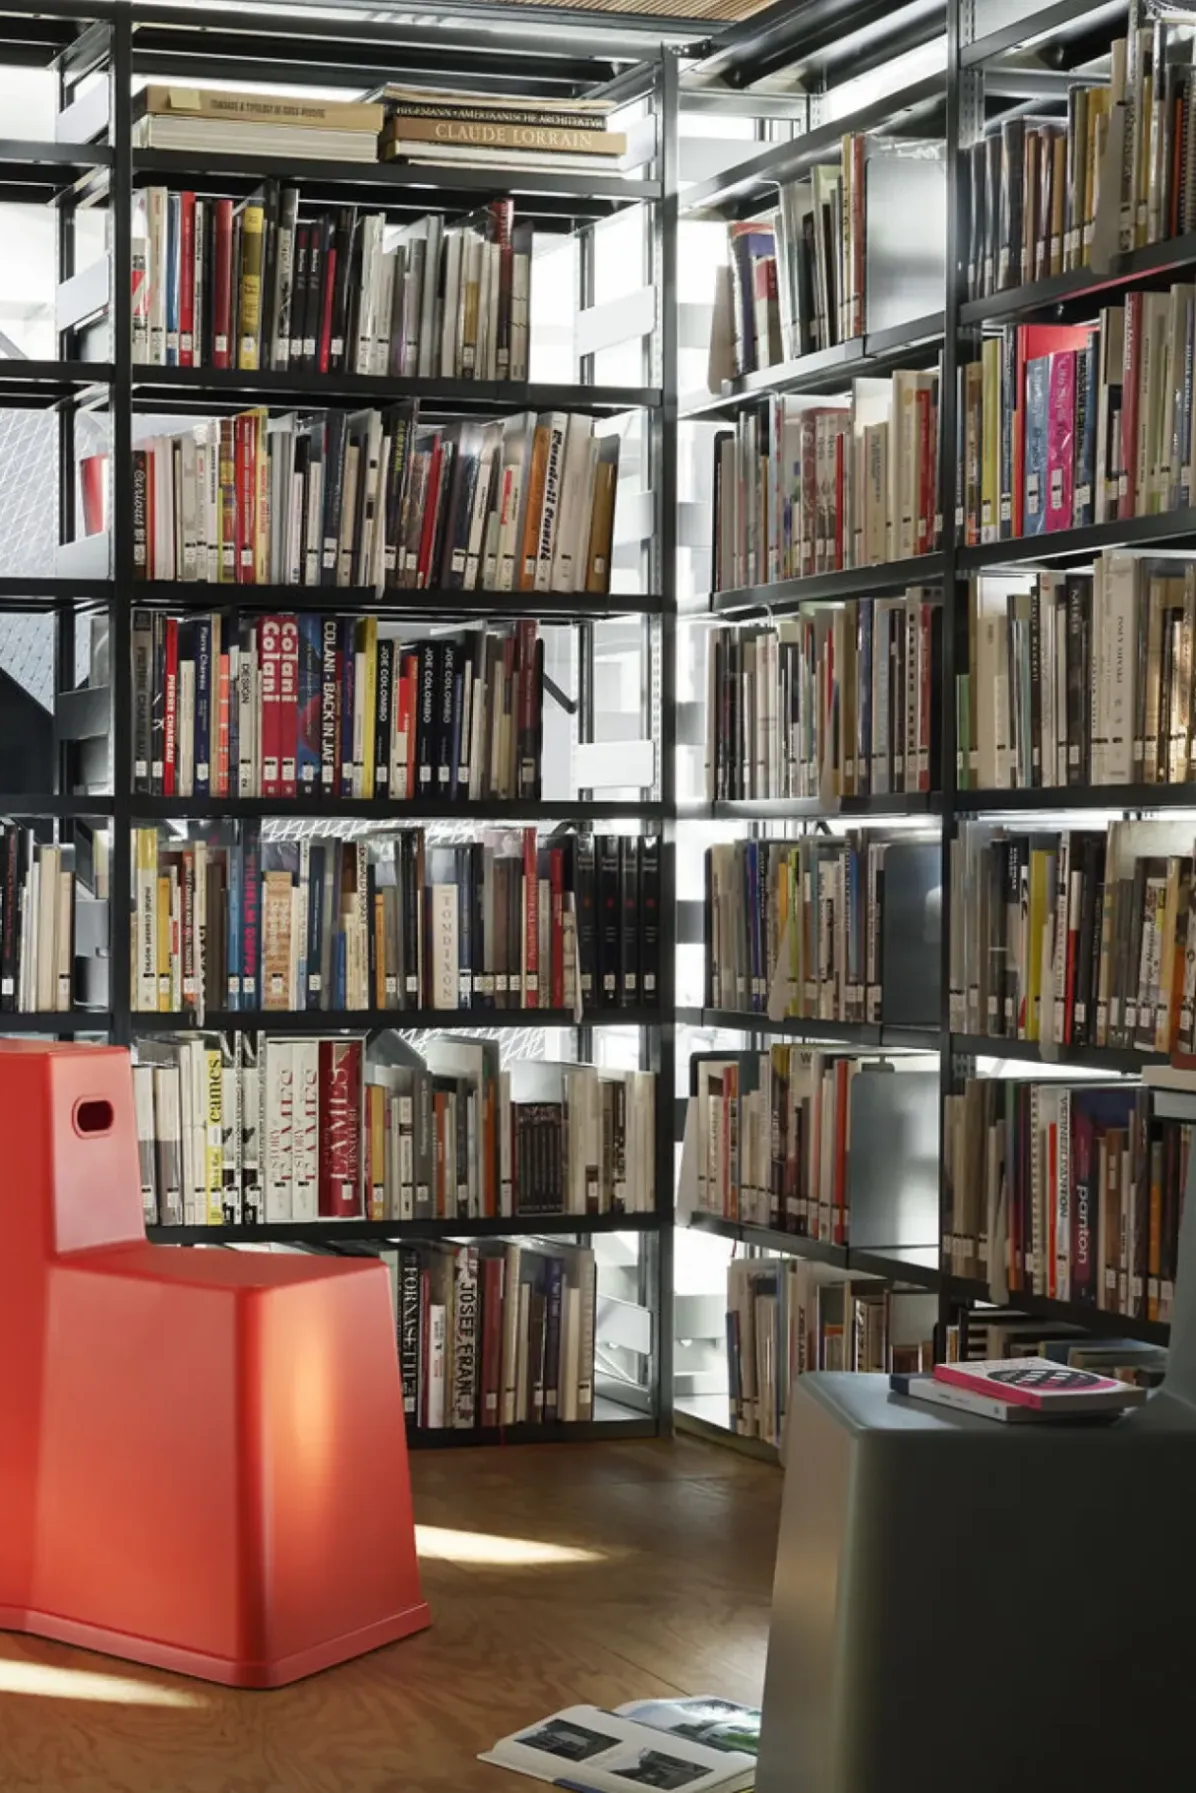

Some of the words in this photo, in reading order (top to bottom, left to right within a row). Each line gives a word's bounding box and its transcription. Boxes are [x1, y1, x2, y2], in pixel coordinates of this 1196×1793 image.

[436, 124, 506, 141] CLAUDE
[512, 130, 593, 147] LORRAIN
[322, 621, 336, 672] COLANI
[379, 645, 389, 667] JOE
[424, 647, 434, 668] JOE
[444, 647, 454, 668] JOE
[166, 675, 176, 711] PIERRE
[321, 682, 335, 719] BACK
[378, 669, 389, 722] COLOMBO
[422, 671, 433, 723] COLOMBO
[442, 671, 453, 723] COLOMBO
[321, 722, 335, 736] IN
[208, 1058, 222, 1123] eames
[330, 1067, 348, 1180] EAMES
[1075, 1185, 1089, 1264] panton
[459, 1283, 475, 1337] JOSEF
